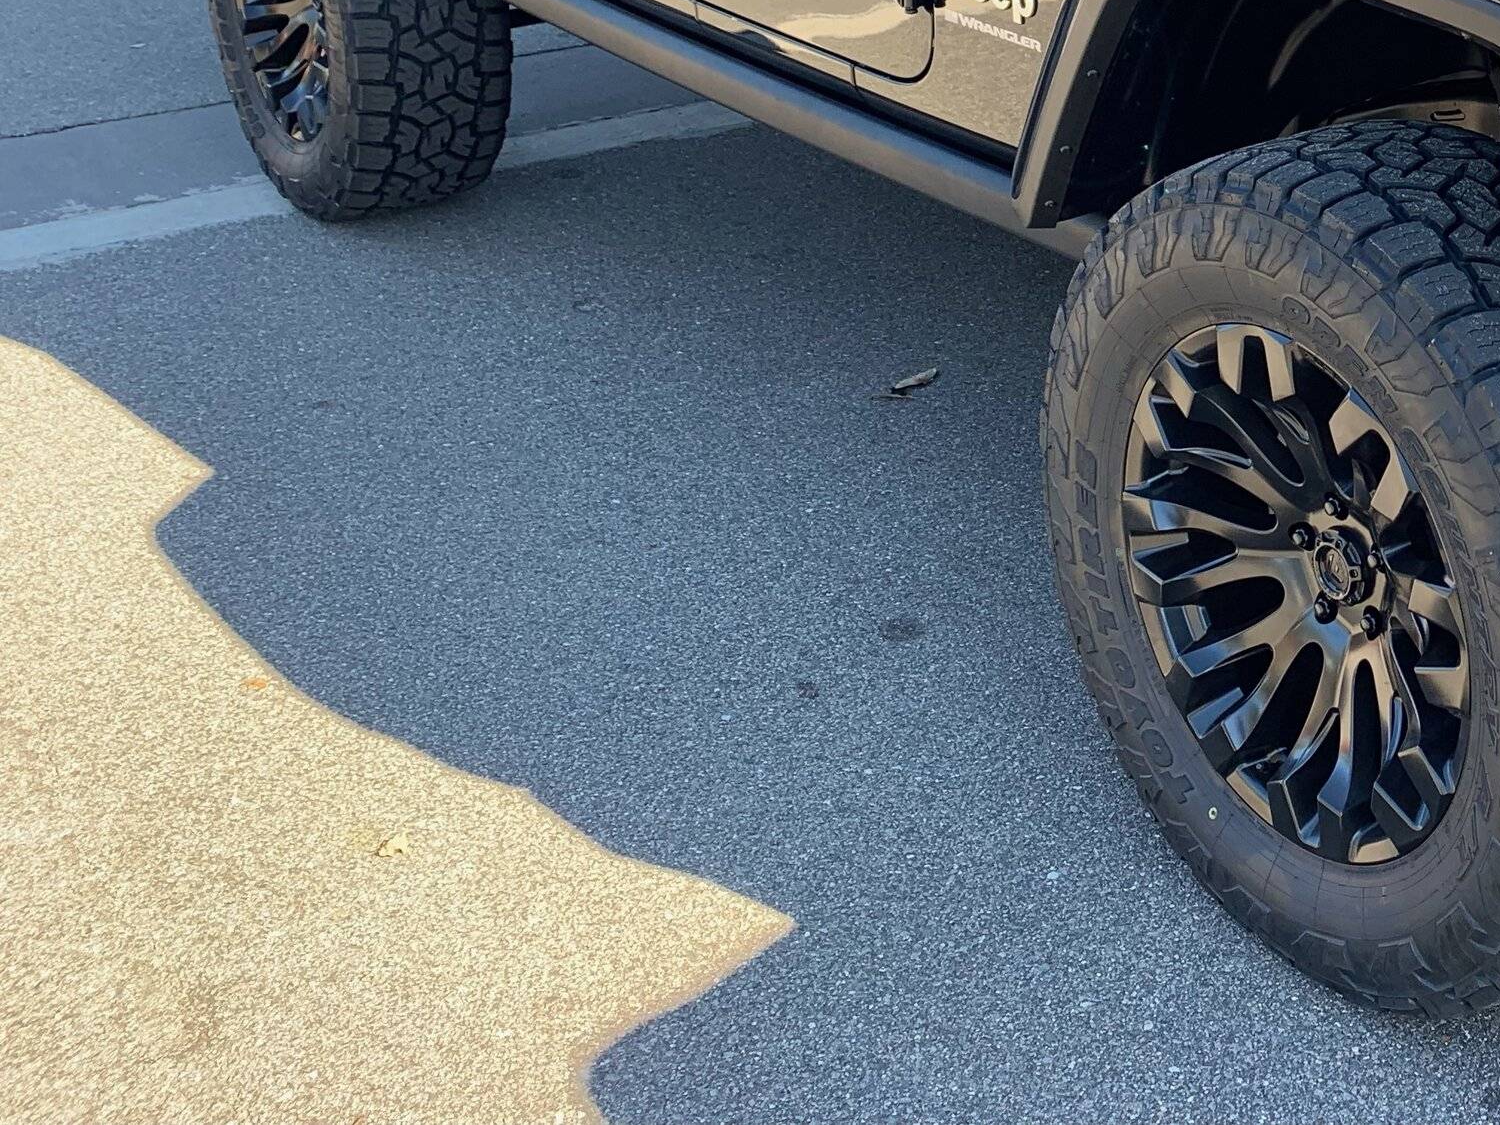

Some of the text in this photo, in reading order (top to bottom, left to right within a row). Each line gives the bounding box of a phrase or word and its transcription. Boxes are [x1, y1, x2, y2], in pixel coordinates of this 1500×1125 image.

[958, 12, 1042, 53] WRANGLER
[1075, 439, 1119, 635] TIRES
[1281, 295, 1398, 413] OPEN
[1398, 427, 1500, 755] COUNTRY
[1105, 646, 1195, 805] TOYO
